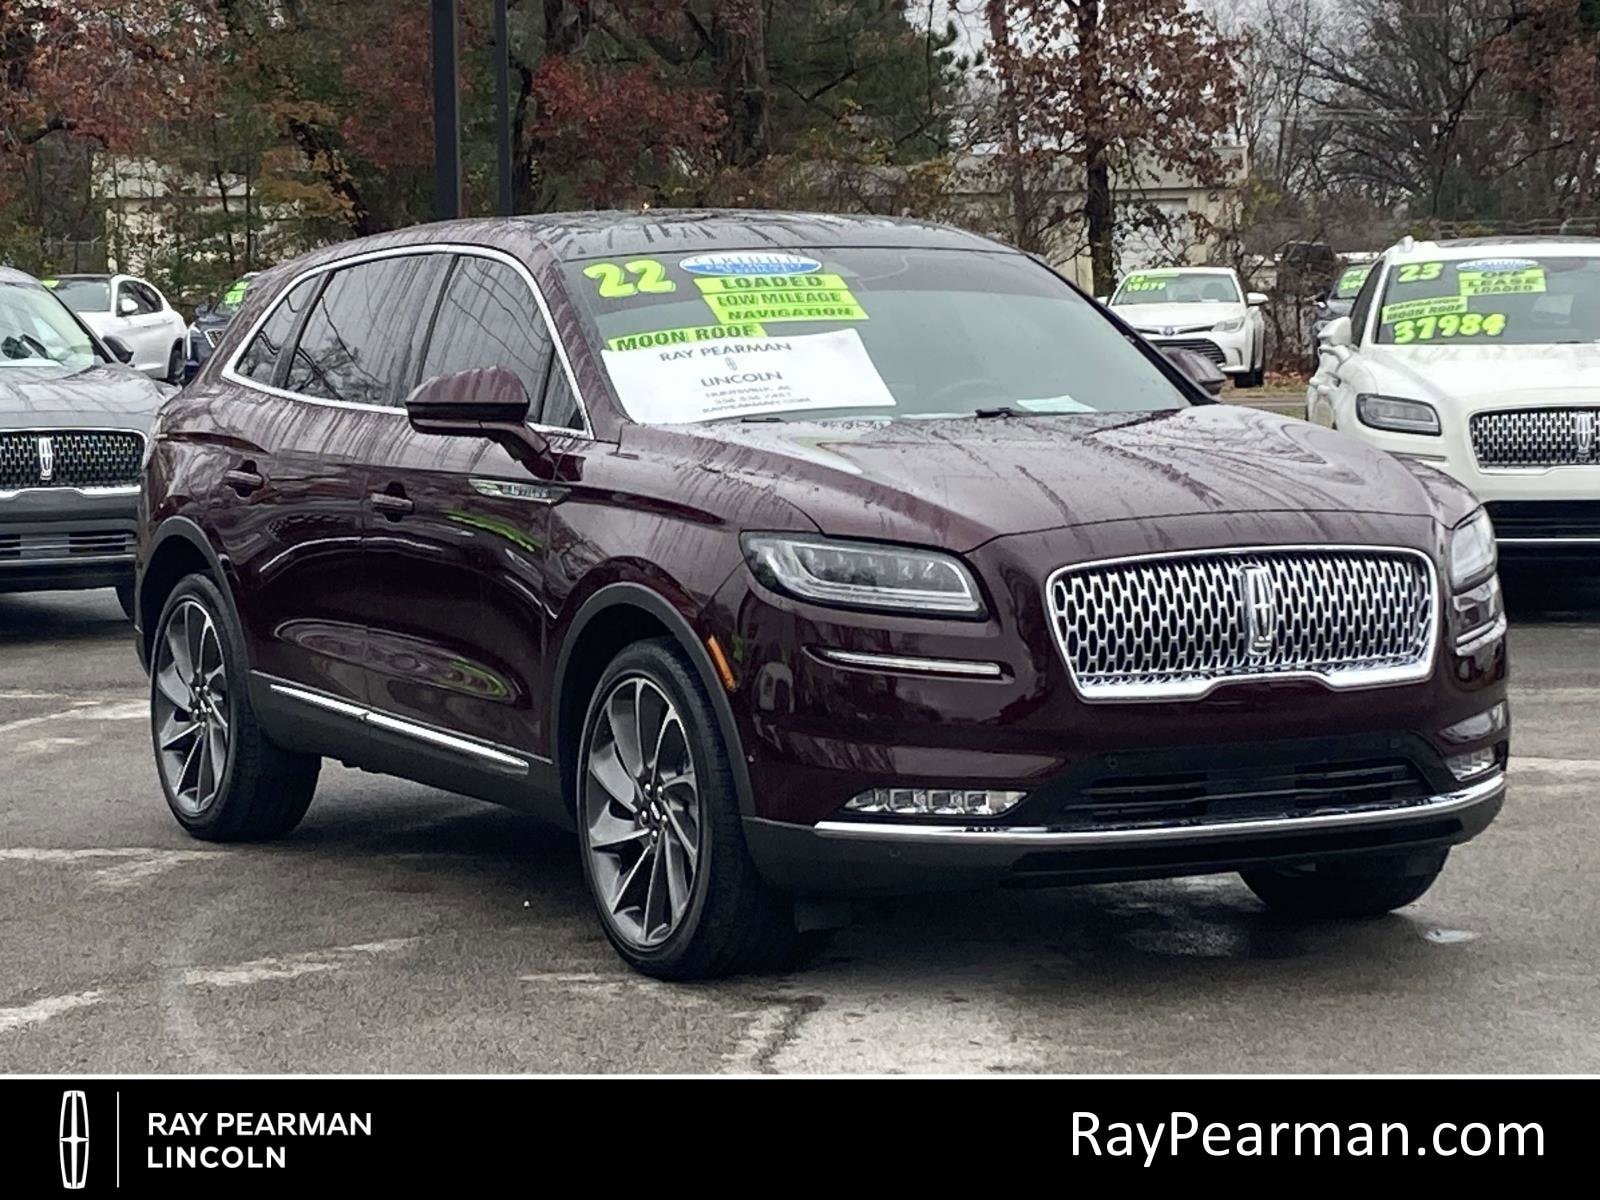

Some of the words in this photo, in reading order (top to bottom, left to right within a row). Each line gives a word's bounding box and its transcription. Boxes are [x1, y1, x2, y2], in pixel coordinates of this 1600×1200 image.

[583, 259, 677, 298] 22
[1397, 262, 1444, 283] 23
[720, 275, 823, 291] LOADED
[717, 293, 759, 307] LOW
[760, 291, 841, 306] MILEAGE
[728, 307, 854, 321] NAVIGATION
[616, 331, 687, 352] MOON
[695, 325, 760, 341] ROOF
[659, 348, 695, 363] RAY
[699, 341, 793, 359] PEARMAN
[700, 371, 783, 387] LINCOLN
